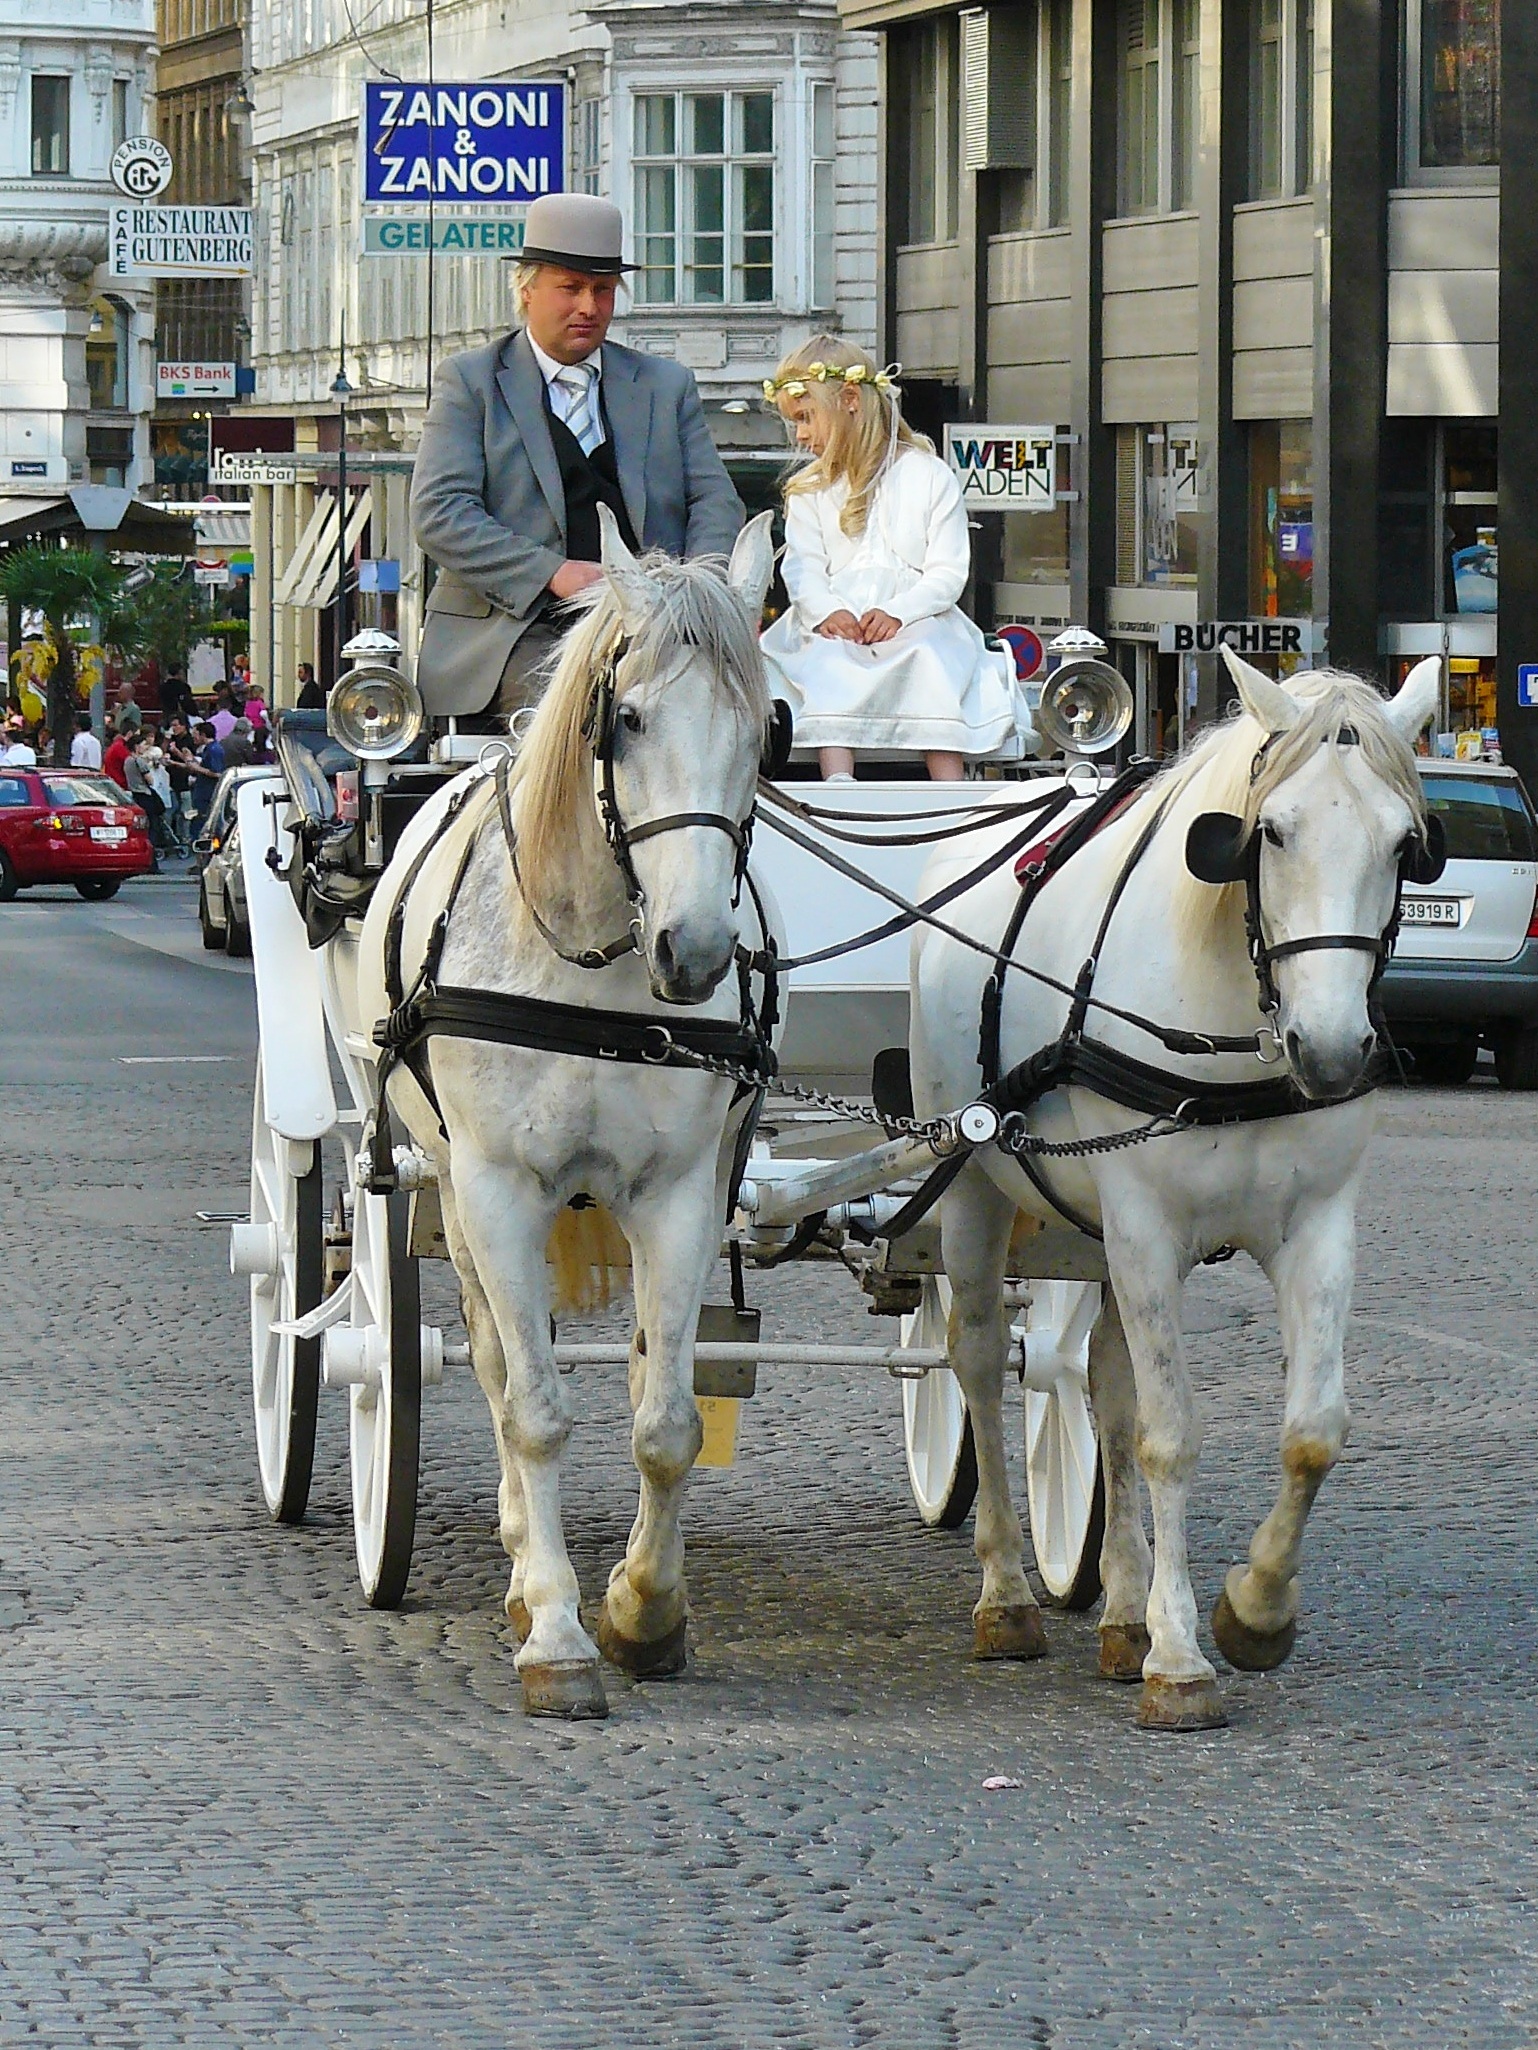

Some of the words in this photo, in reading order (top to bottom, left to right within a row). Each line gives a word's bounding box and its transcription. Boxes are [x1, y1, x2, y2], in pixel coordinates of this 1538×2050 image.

[379, 90, 549, 127] ZANONI
[114, 139, 170, 169] PENSION
[453, 129, 477, 155] &
[379, 157, 549, 193] ZANONI
[132, 209, 252, 235] RESTAURANT
[379, 222, 525, 249] GELATERI
[132, 237, 252, 263] GUTENBERG
[160, 366, 191, 380] BKS
[194, 366, 232, 380] Bank
[951, 440, 1053, 470] WELT
[214, 467, 261, 480] italian
[266, 467, 292, 480] bar
[954, 468, 1051, 496] ADEN
[1174, 622, 1302, 652] BÜCHER
[1445, 904, 1454, 919] R
